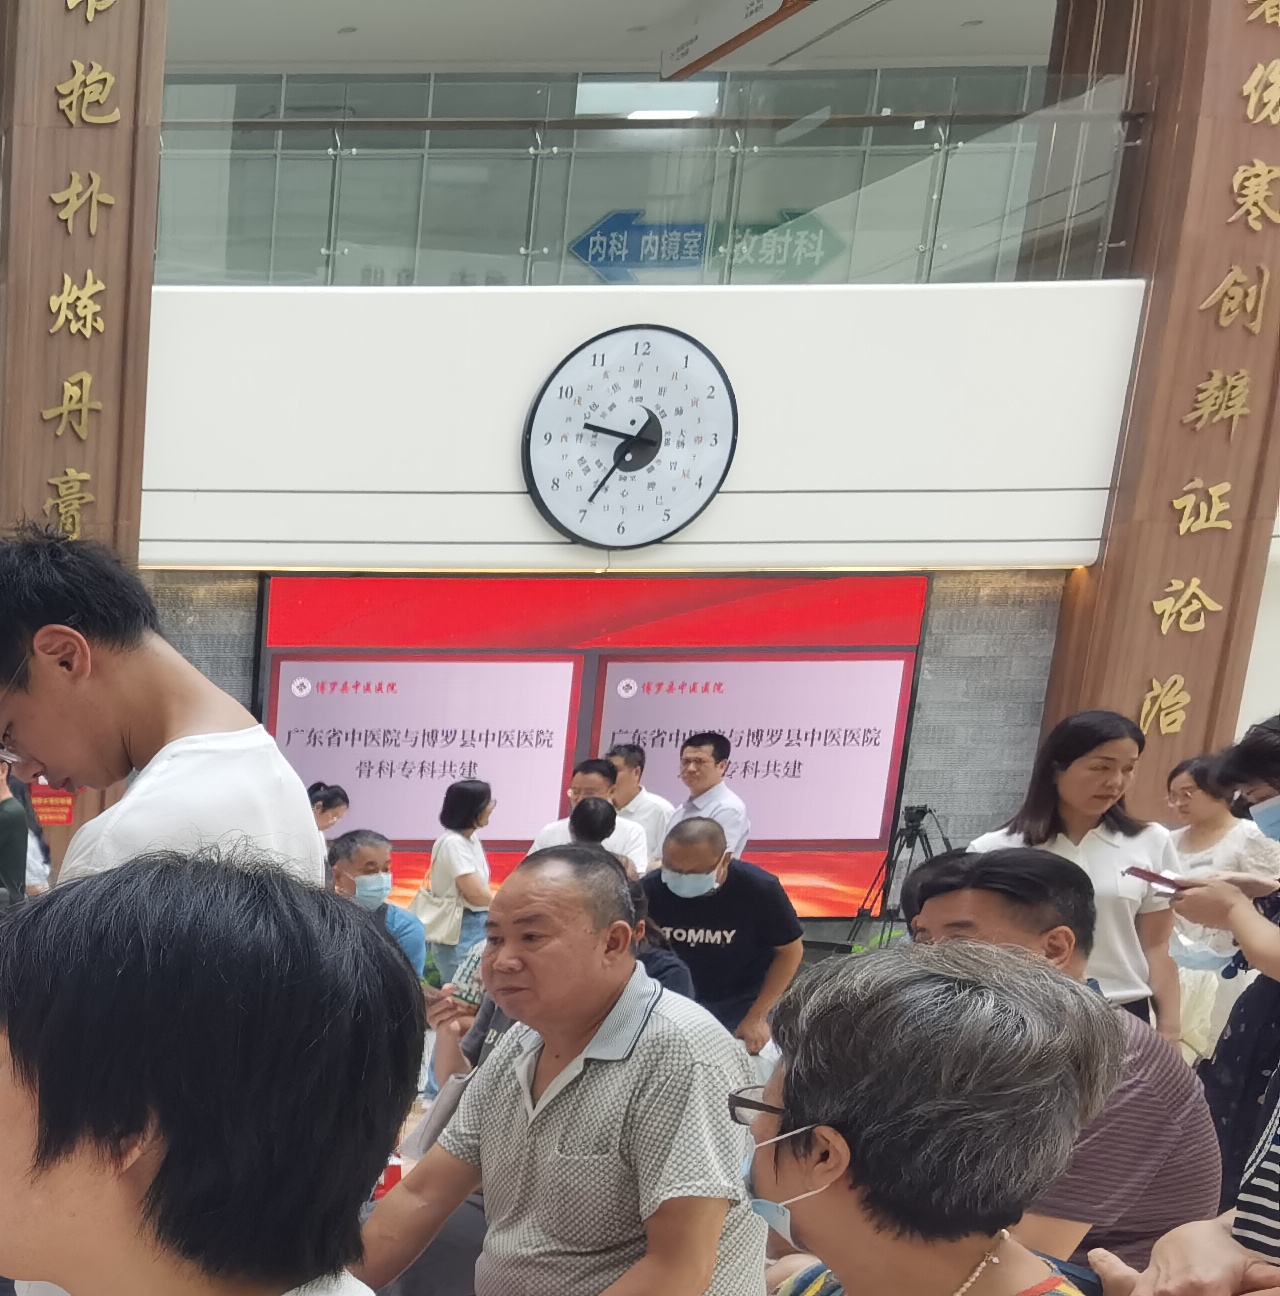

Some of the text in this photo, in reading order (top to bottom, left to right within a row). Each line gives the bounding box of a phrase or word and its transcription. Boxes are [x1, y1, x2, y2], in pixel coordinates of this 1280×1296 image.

[588, 230, 702, 262] 内科 内镜室
[733, 229, 825, 266] 放射科
[633, 342, 651, 356] 12
[591, 353, 606, 367] 11
[681, 355, 690, 369] 1
[558, 385, 573, 400] 10
[707, 386, 715, 399] 2
[544, 432, 552, 446] 9
[710, 433, 718, 447] 3
[551, 477, 560, 491] 8
[695, 476, 703, 489] 4
[579, 510, 587, 523] 7
[662, 509, 671, 522] 5
[617, 520, 625, 535] 6
[285, 728, 554, 749] 广东省中医院与博罗县中医医院
[356, 760, 479, 779] 骨科专科共建
[661, 926, 737, 945] TOMMY
